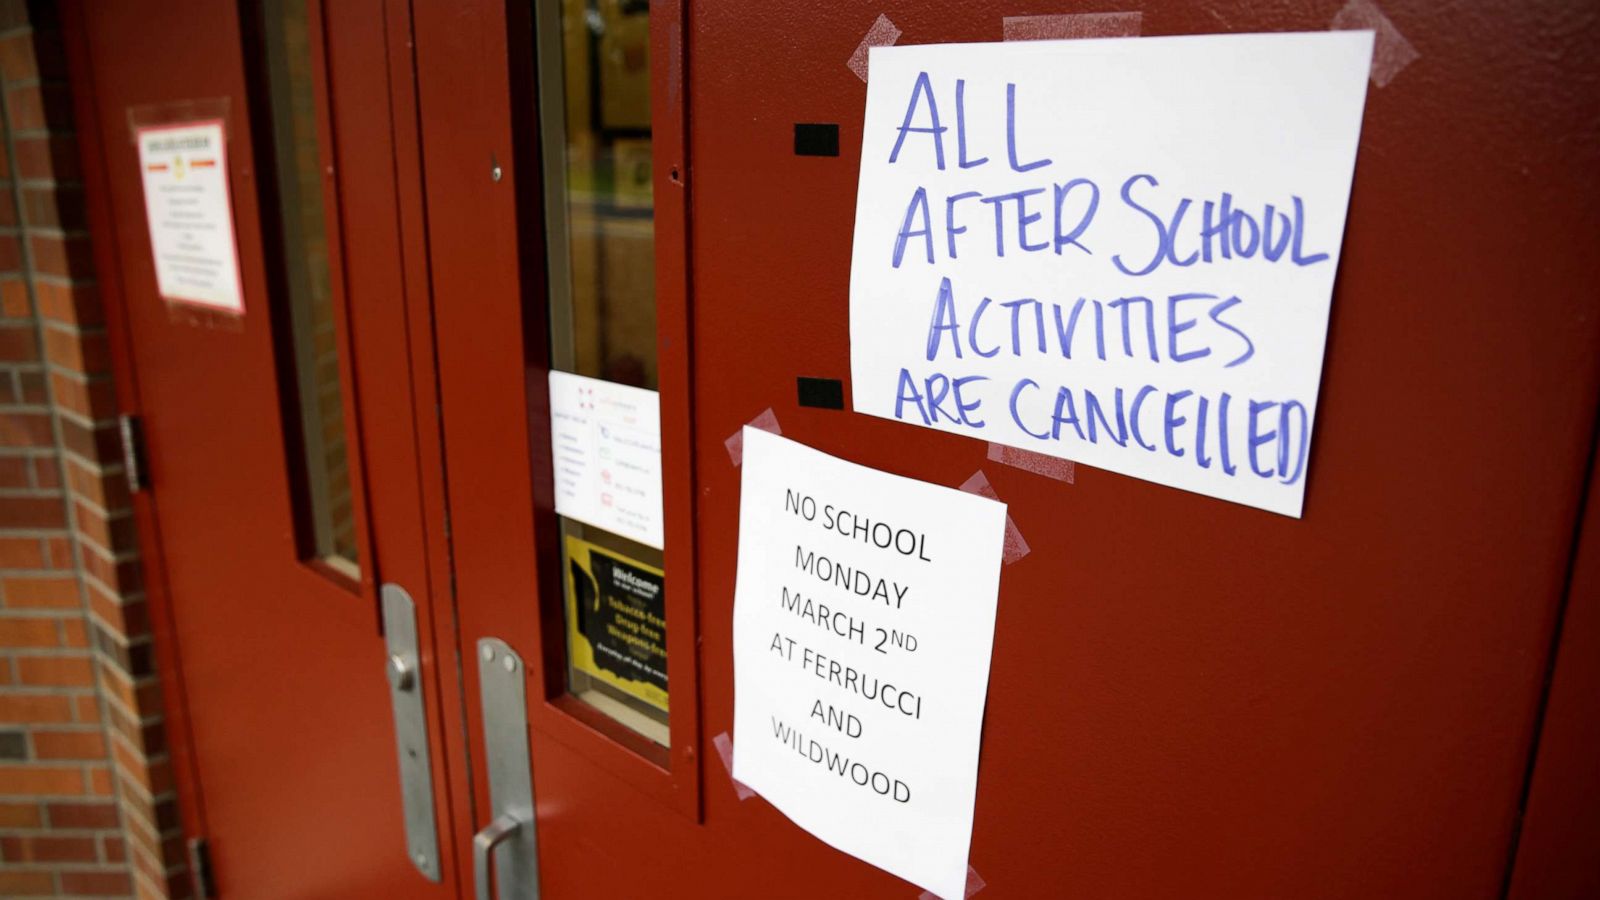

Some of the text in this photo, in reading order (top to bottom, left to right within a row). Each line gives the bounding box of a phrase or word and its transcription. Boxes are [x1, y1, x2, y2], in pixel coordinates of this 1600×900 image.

[889, 71, 1053, 174] ALL
[891, 174, 1330, 276] AFTER SCHOOL
[926, 277, 1255, 369] ACTIVITIES
[894, 367, 1309, 486] ARE CANCELLED
[785, 487, 932, 563] NO SCHOOL
[612, 566, 659, 594] Welcome
[781, 586, 918, 655] MARCH 2ND
[795, 544, 909, 610] MONDAY
[770, 632, 922, 720] AT FERRUCCI
[810, 699, 863, 739] AND
[771, 715, 911, 804] WILDWOOD
